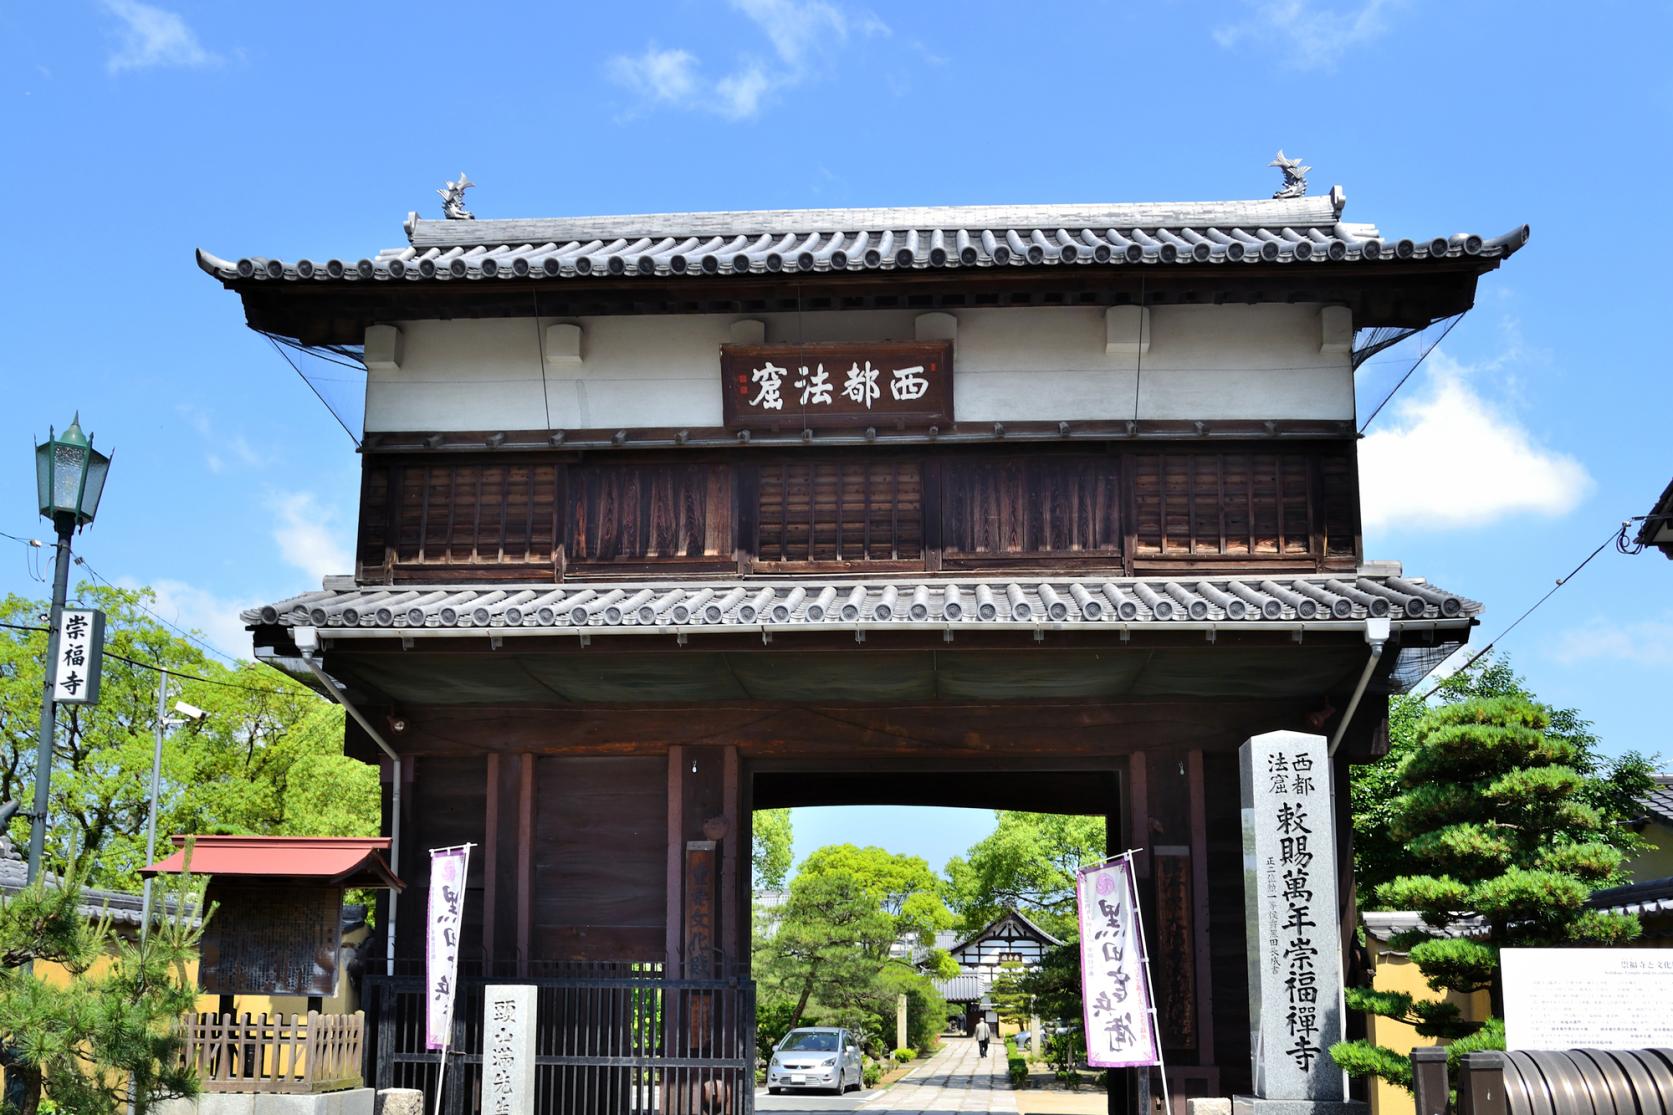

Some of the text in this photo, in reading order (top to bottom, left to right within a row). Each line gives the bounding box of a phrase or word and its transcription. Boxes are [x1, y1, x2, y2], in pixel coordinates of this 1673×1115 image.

[60, 614, 89, 695] 崇福寺
[1267, 752, 1289, 794] 法窟
[1291, 751, 1315, 797] 西都
